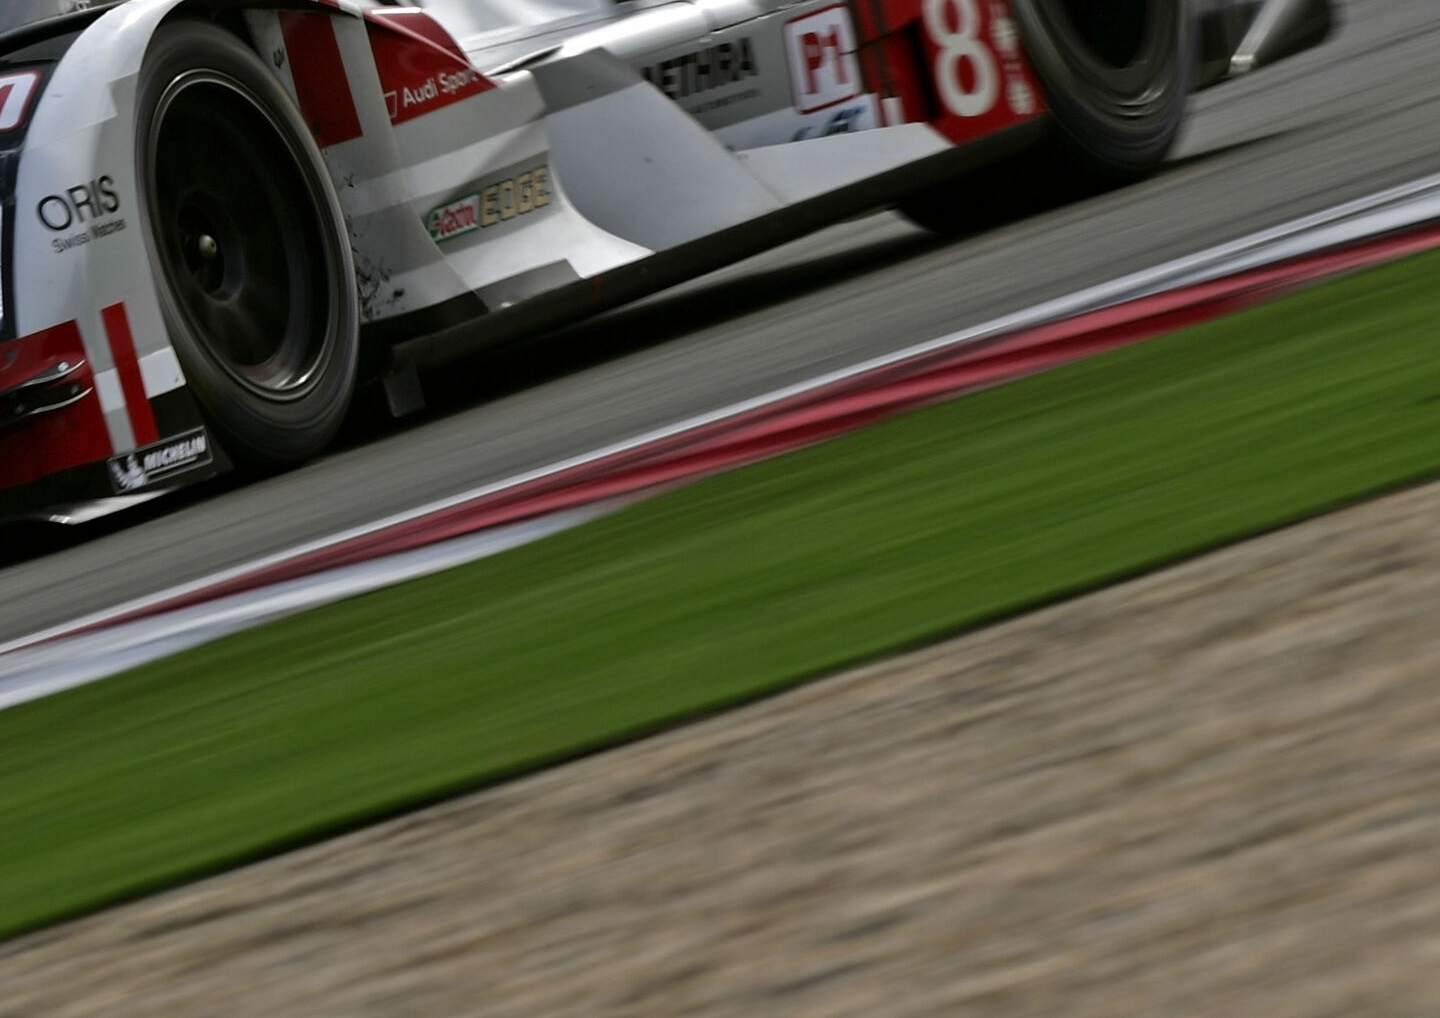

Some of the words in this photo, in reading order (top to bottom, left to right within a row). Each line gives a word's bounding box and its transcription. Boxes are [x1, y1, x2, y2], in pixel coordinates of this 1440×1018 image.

[798, 24, 850, 95] P1
[402, 77, 440, 108] Audi
[37, 173, 120, 232] ORIS
[480, 165, 551, 229] EDGE
[143, 435, 206, 472] MICHELIN
